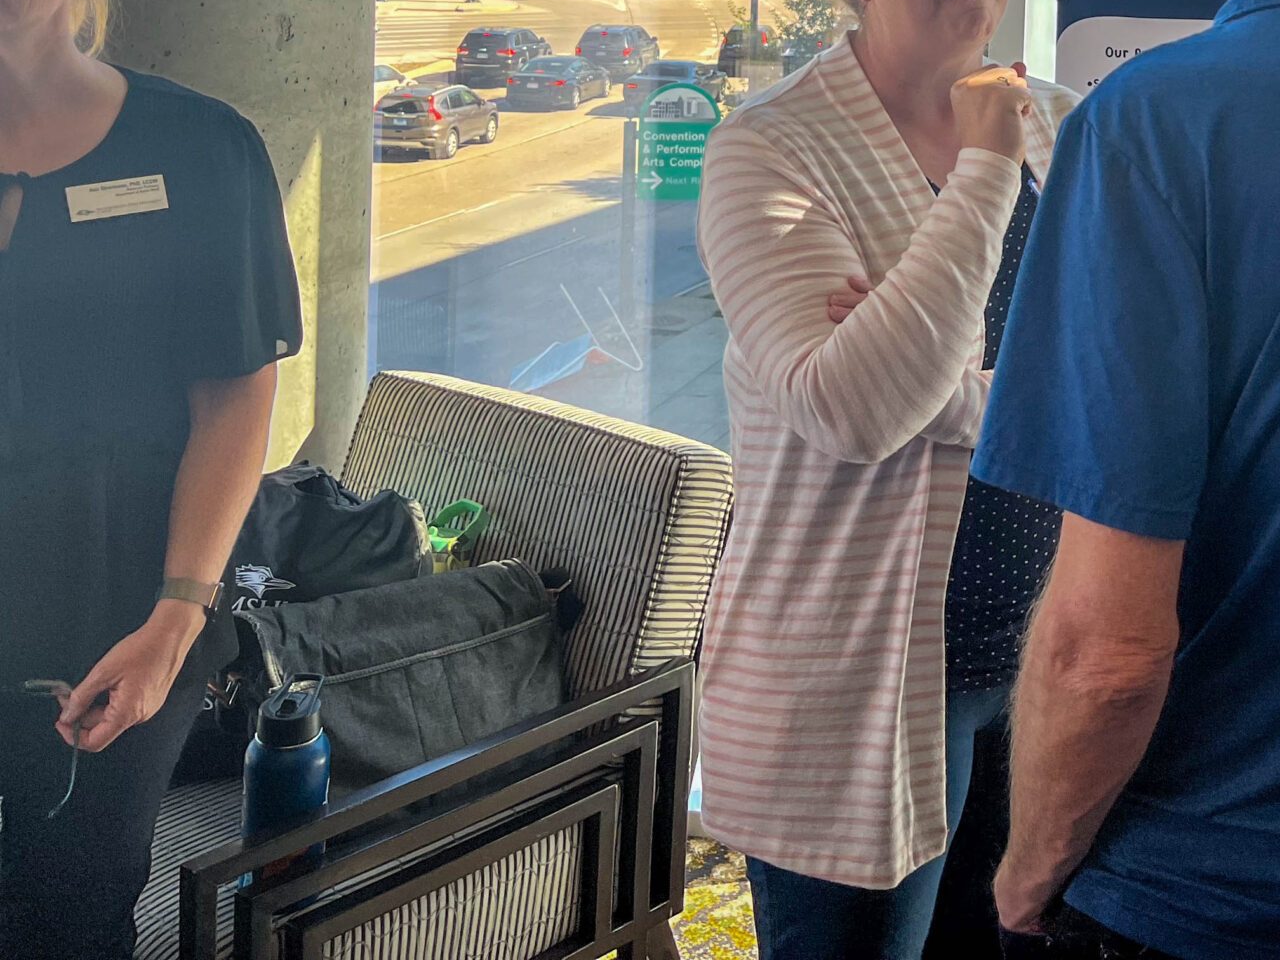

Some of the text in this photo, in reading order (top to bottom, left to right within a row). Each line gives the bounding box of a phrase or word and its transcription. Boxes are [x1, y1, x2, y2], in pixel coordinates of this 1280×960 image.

[1105, 46, 1128, 58] Our
[643, 131, 705, 141] Convention
[643, 145, 705, 154] & Performi
[643, 158, 703, 168] Arts Compl
